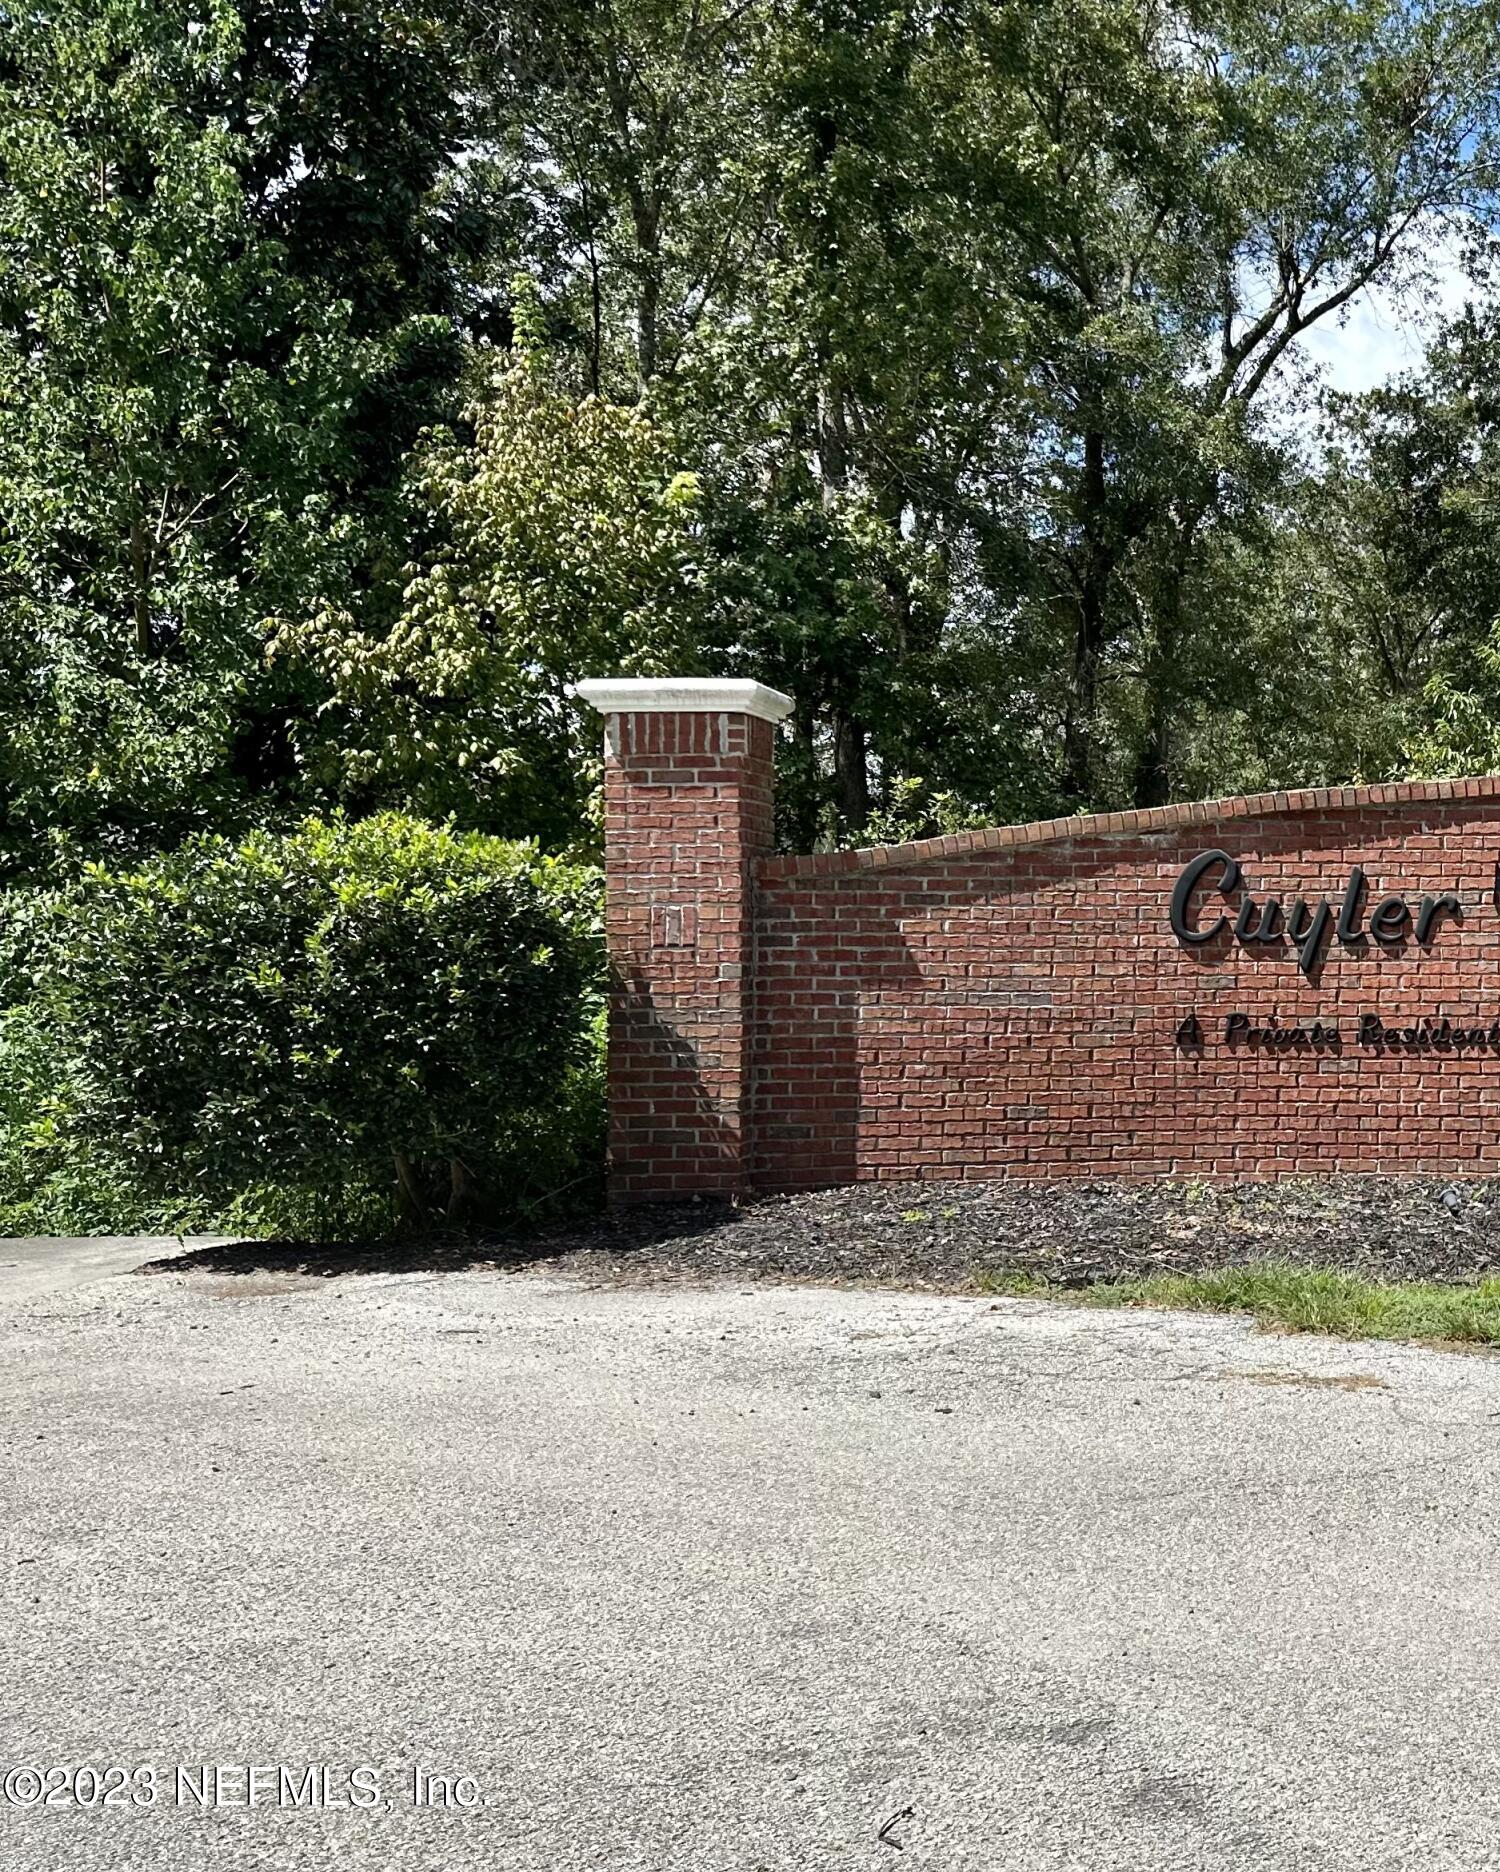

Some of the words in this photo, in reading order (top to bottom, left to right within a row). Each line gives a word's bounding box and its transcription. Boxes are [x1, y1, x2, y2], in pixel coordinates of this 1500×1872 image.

[1170, 849, 1460, 974] Cuyler
[1176, 1013, 1200, 1045] A
[1224, 1012, 1339, 1046] Private
